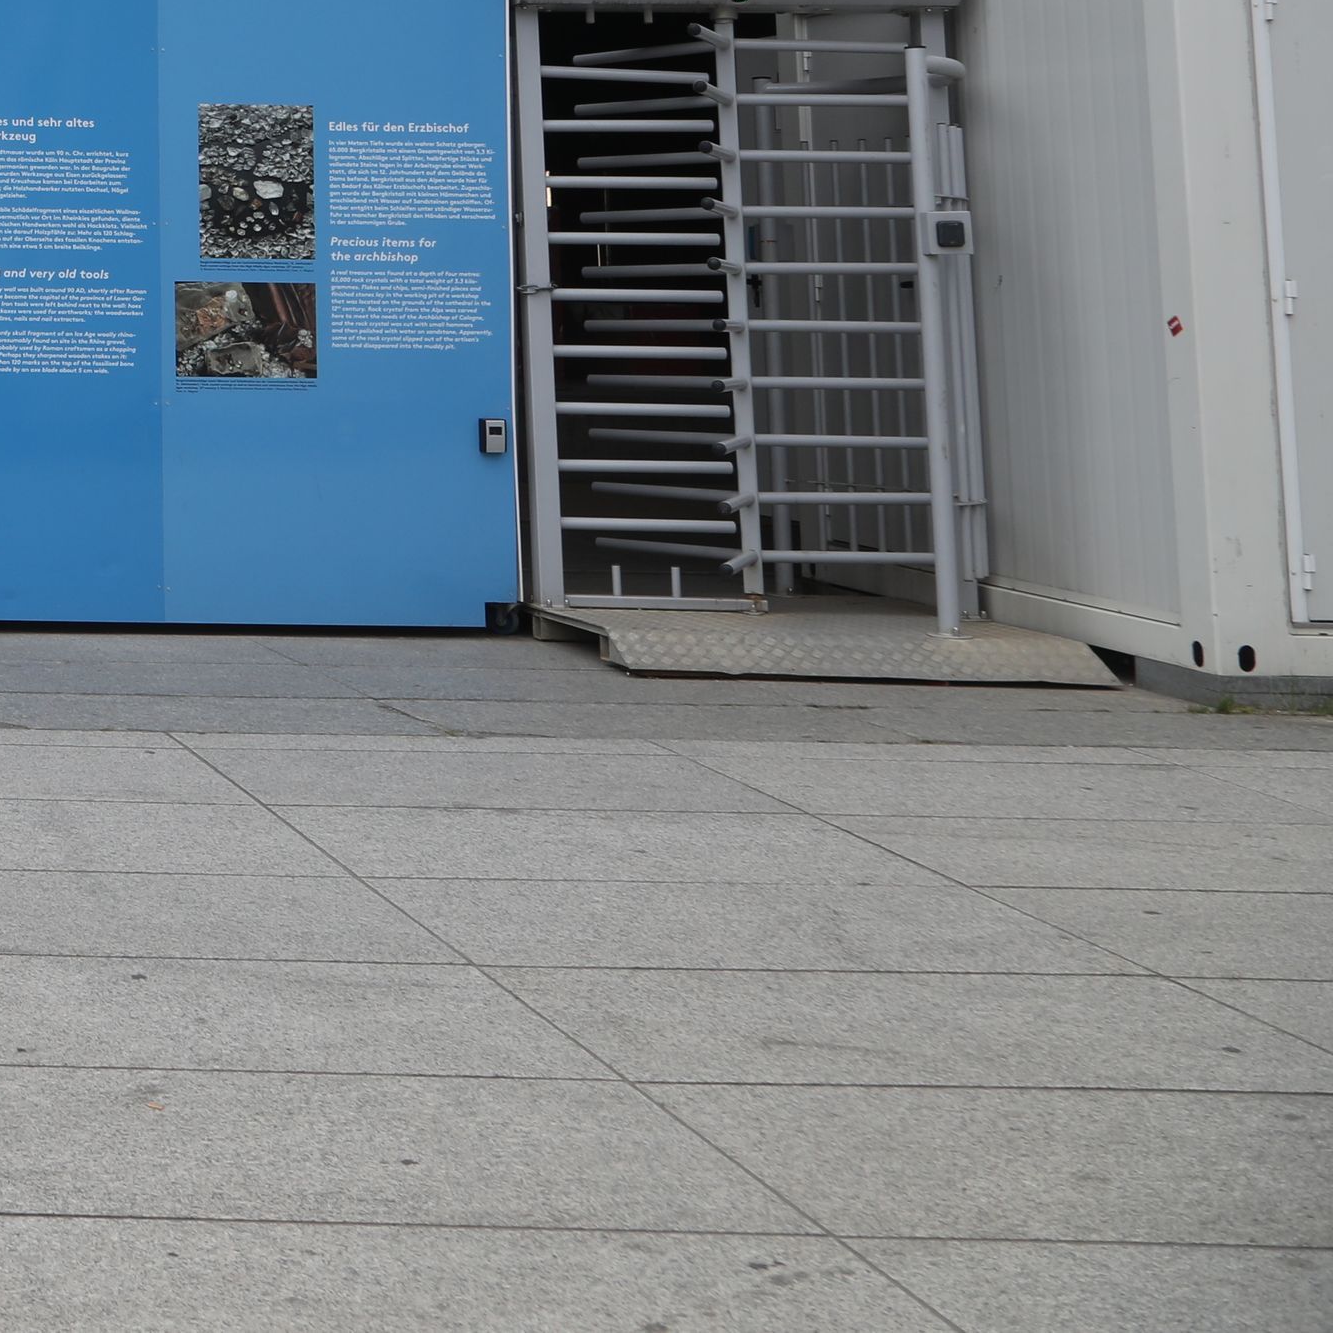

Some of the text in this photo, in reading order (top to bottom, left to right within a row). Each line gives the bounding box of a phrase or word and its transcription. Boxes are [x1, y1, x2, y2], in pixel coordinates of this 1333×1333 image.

[12, 117, 34, 127] und
[38, 117, 62, 127] sehr
[66, 118, 95, 128] altes
[329, 122, 469, 132] Edles für den Erzbischof
[330, 236, 437, 248] Precious items for
[331, 251, 418, 264] the archbishop
[3, 268, 26, 278] and
[29, 271, 55, 281] very
[58, 269, 77, 279] old
[80, 269, 109, 279] tools
